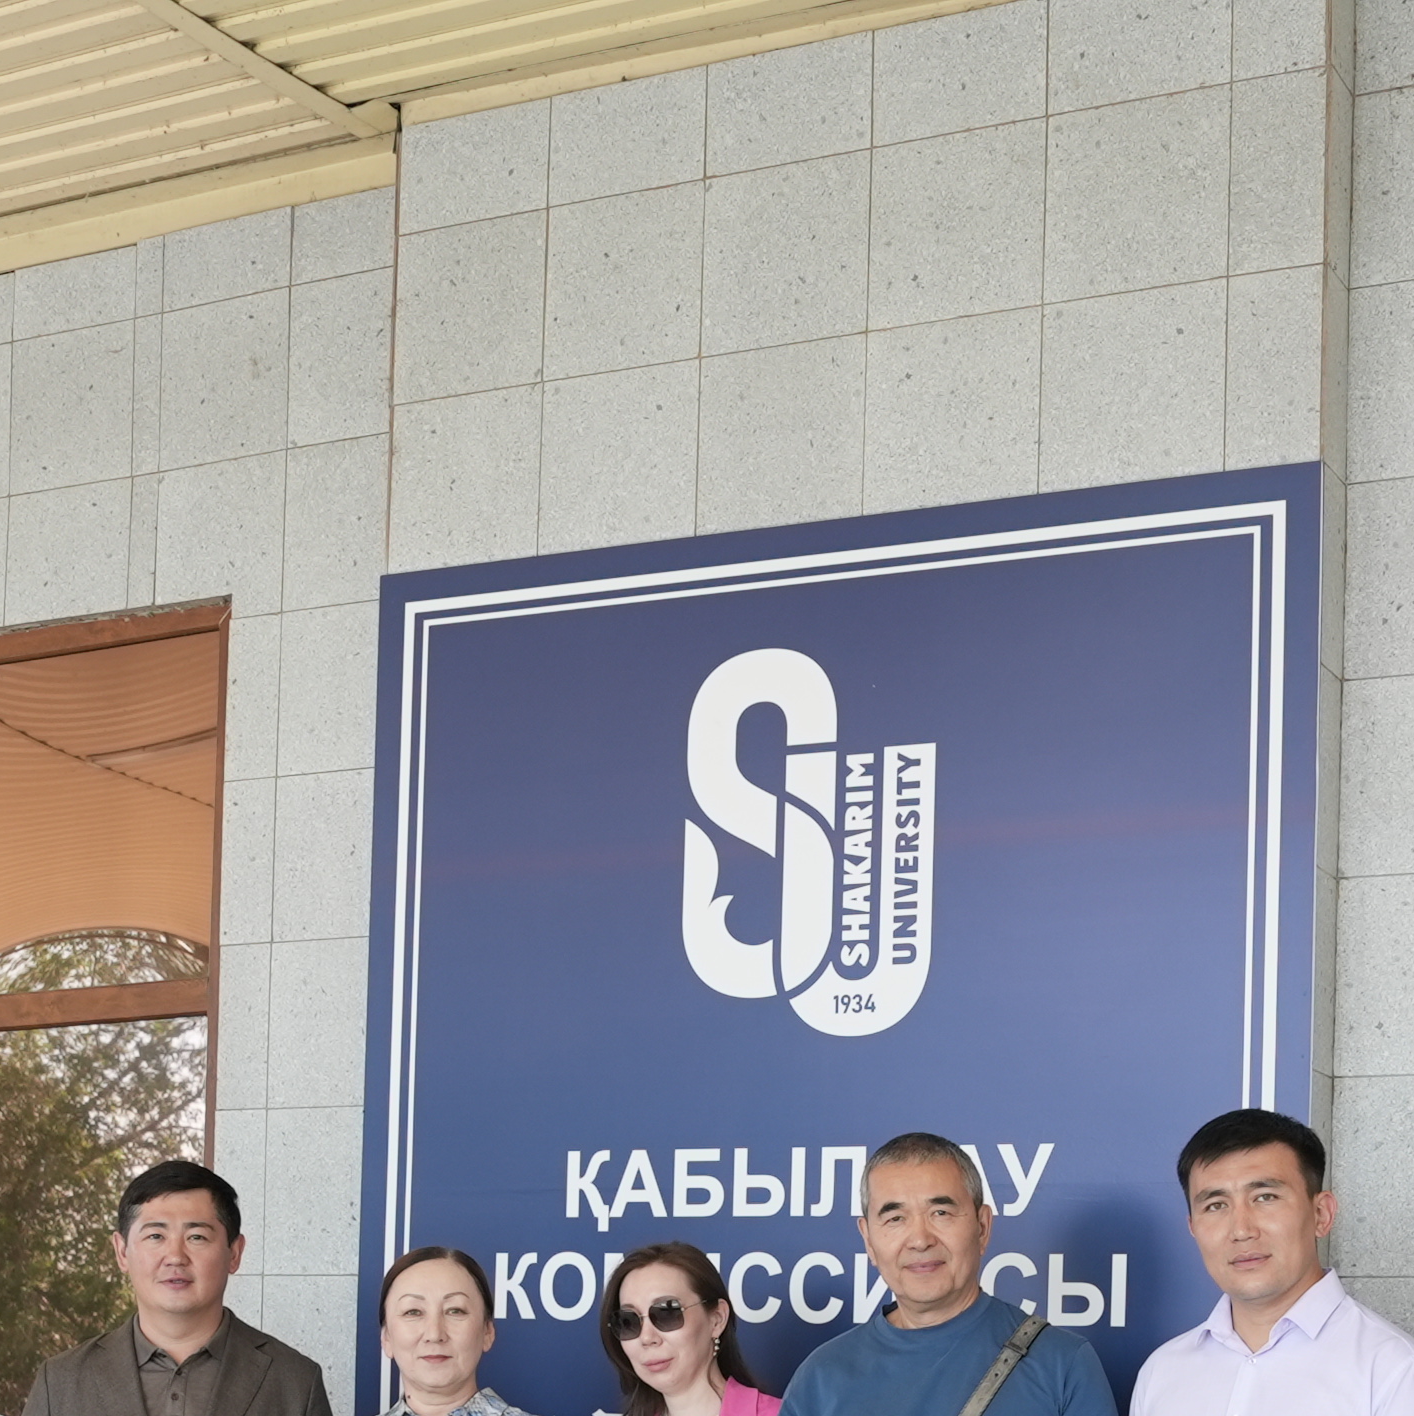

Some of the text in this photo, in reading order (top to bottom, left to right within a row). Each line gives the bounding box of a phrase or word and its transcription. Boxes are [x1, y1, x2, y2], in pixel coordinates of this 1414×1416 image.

[840, 752, 875, 968] SHAKARIM
[891, 752, 922, 966] UNIVERSITY
[833, 994, 876, 1014] 1934
[565, 1143, 1055, 1233] ҚАБЫЛУ
[494, 1251, 1126, 1327] КОССИСЫ
